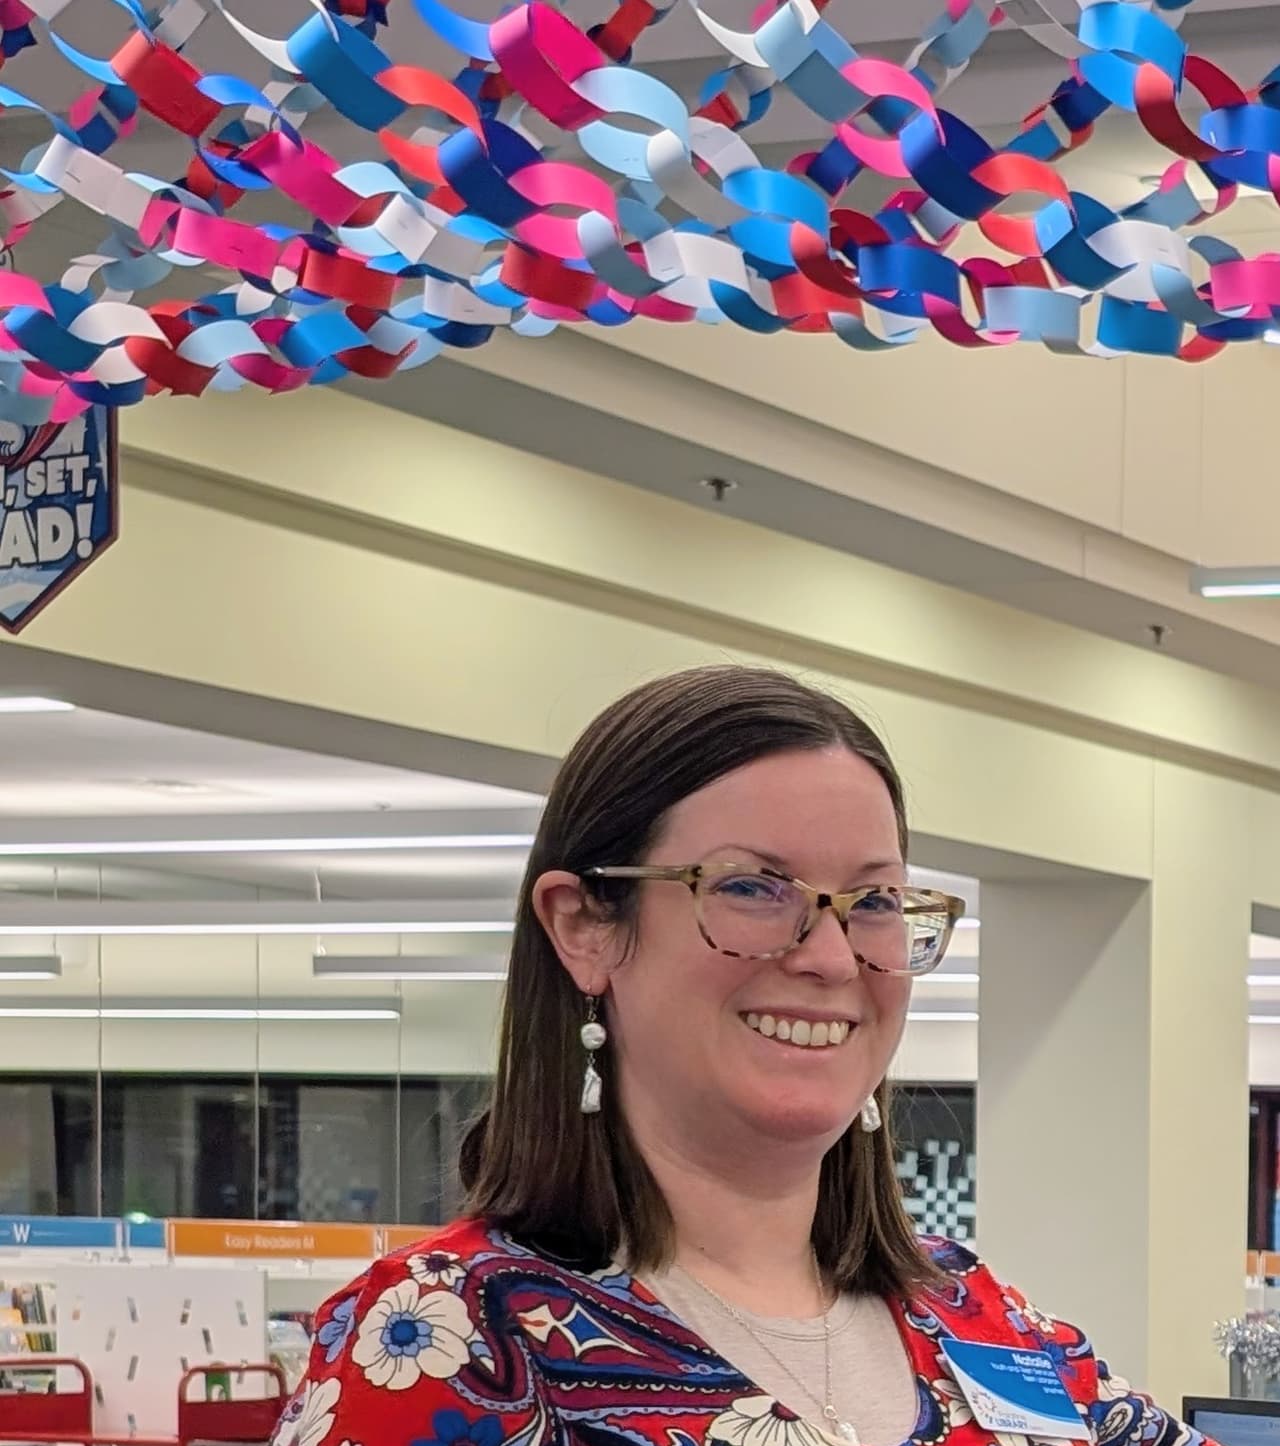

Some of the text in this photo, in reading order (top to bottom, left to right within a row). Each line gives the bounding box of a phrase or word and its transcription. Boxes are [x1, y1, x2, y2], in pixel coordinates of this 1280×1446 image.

[26, 455, 97, 498] SET,
[0, 503, 94, 567] AD!
[13, 1224, 30, 1243] W
